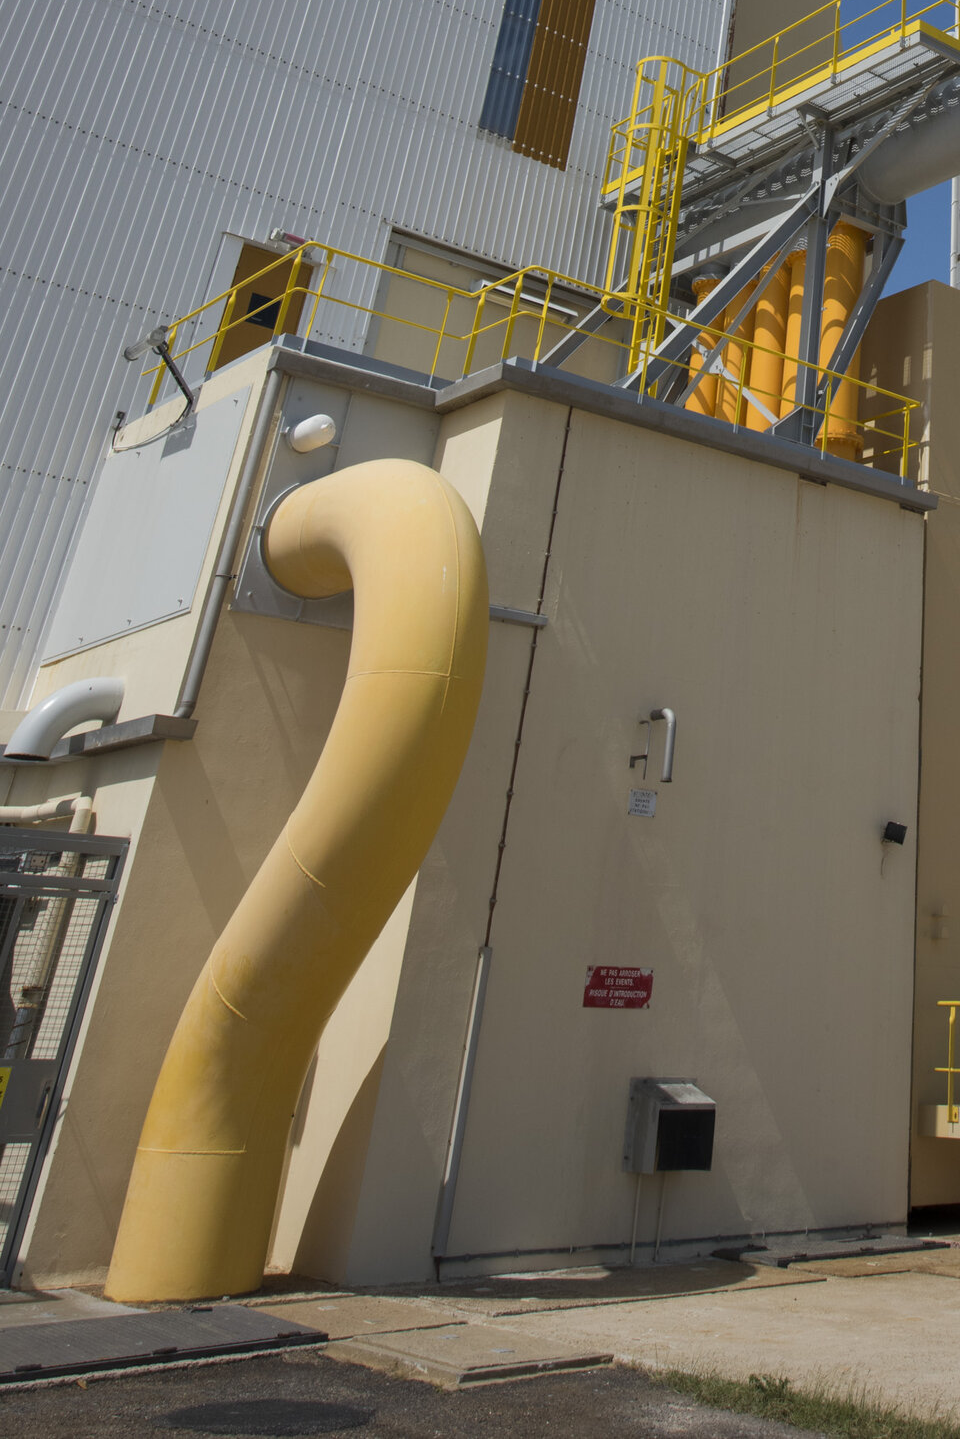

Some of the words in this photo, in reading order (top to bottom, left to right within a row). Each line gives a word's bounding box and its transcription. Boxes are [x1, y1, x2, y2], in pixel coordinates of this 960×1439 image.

[608, 969, 618, 977] PAS
[619, 969, 641, 978] ARROSER
[604, 977, 614, 986] LES
[588, 989, 609, 998] RISQUE
